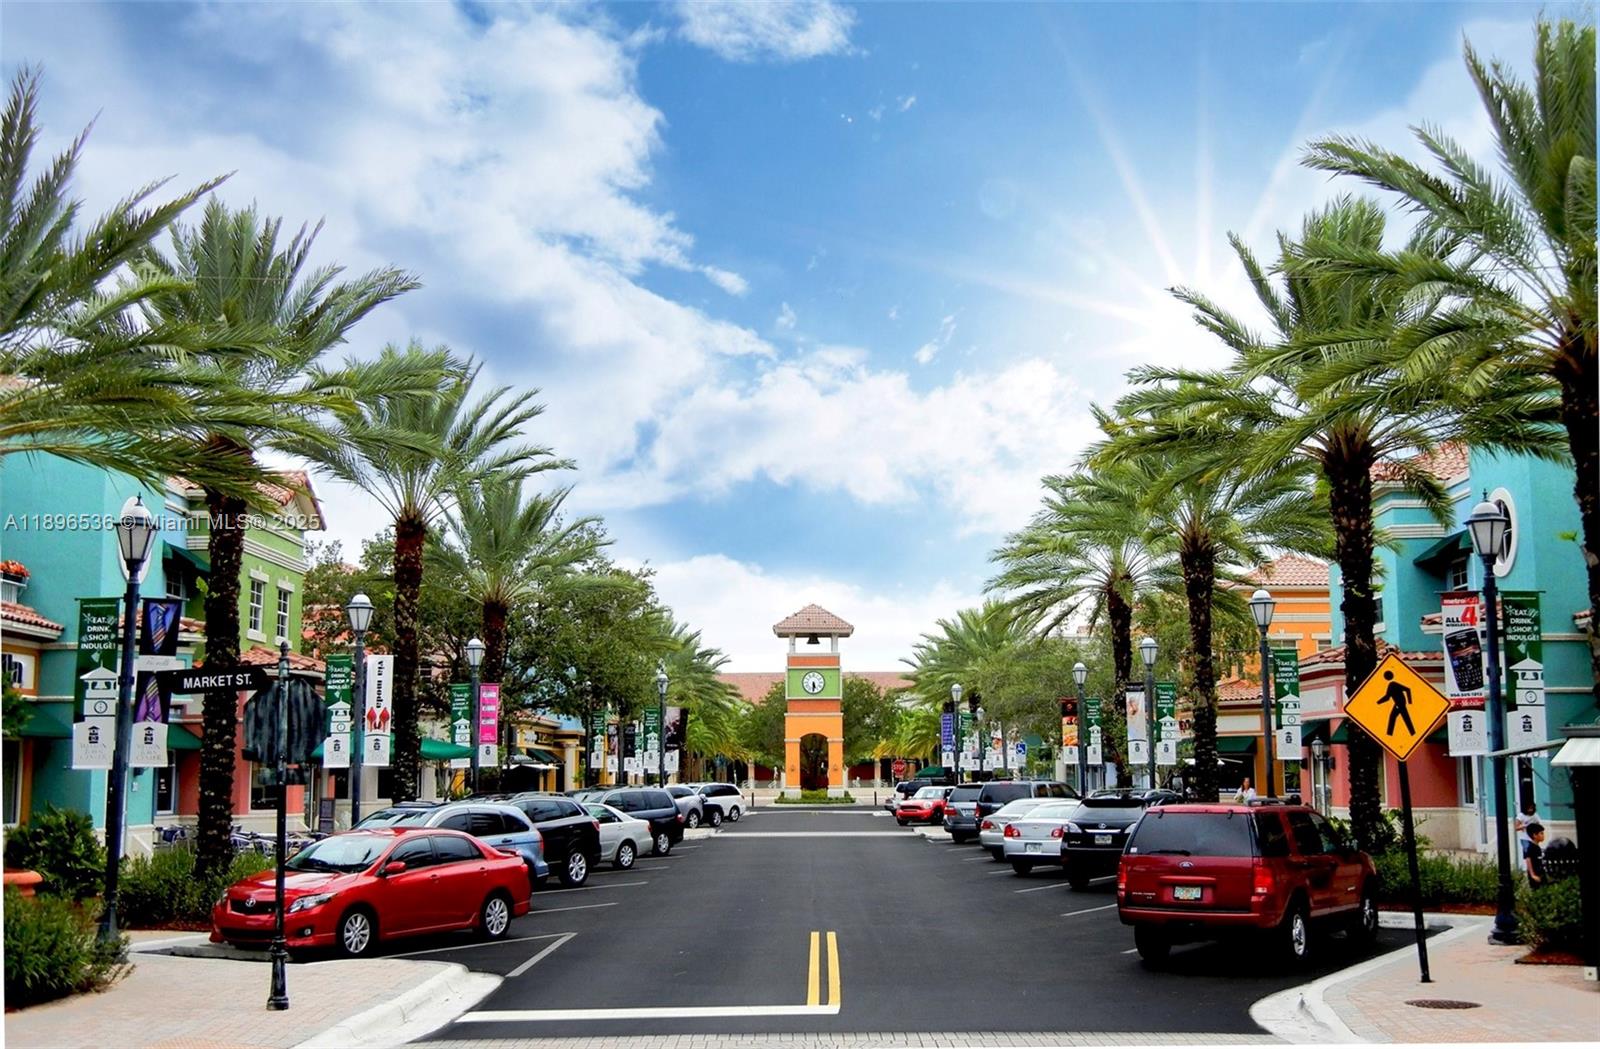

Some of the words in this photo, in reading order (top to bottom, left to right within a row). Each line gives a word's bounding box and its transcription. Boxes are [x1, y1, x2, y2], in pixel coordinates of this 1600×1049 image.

[92, 616, 108, 624] EAT.
[1461, 606, 1477, 626] 4
[87, 625, 111, 633] DRINK.
[88, 633, 109, 641] SHOP.
[80, 642, 116, 650] INDULGE!
[183, 674, 234, 689] MARKET
[235, 673, 252, 686] ST.
